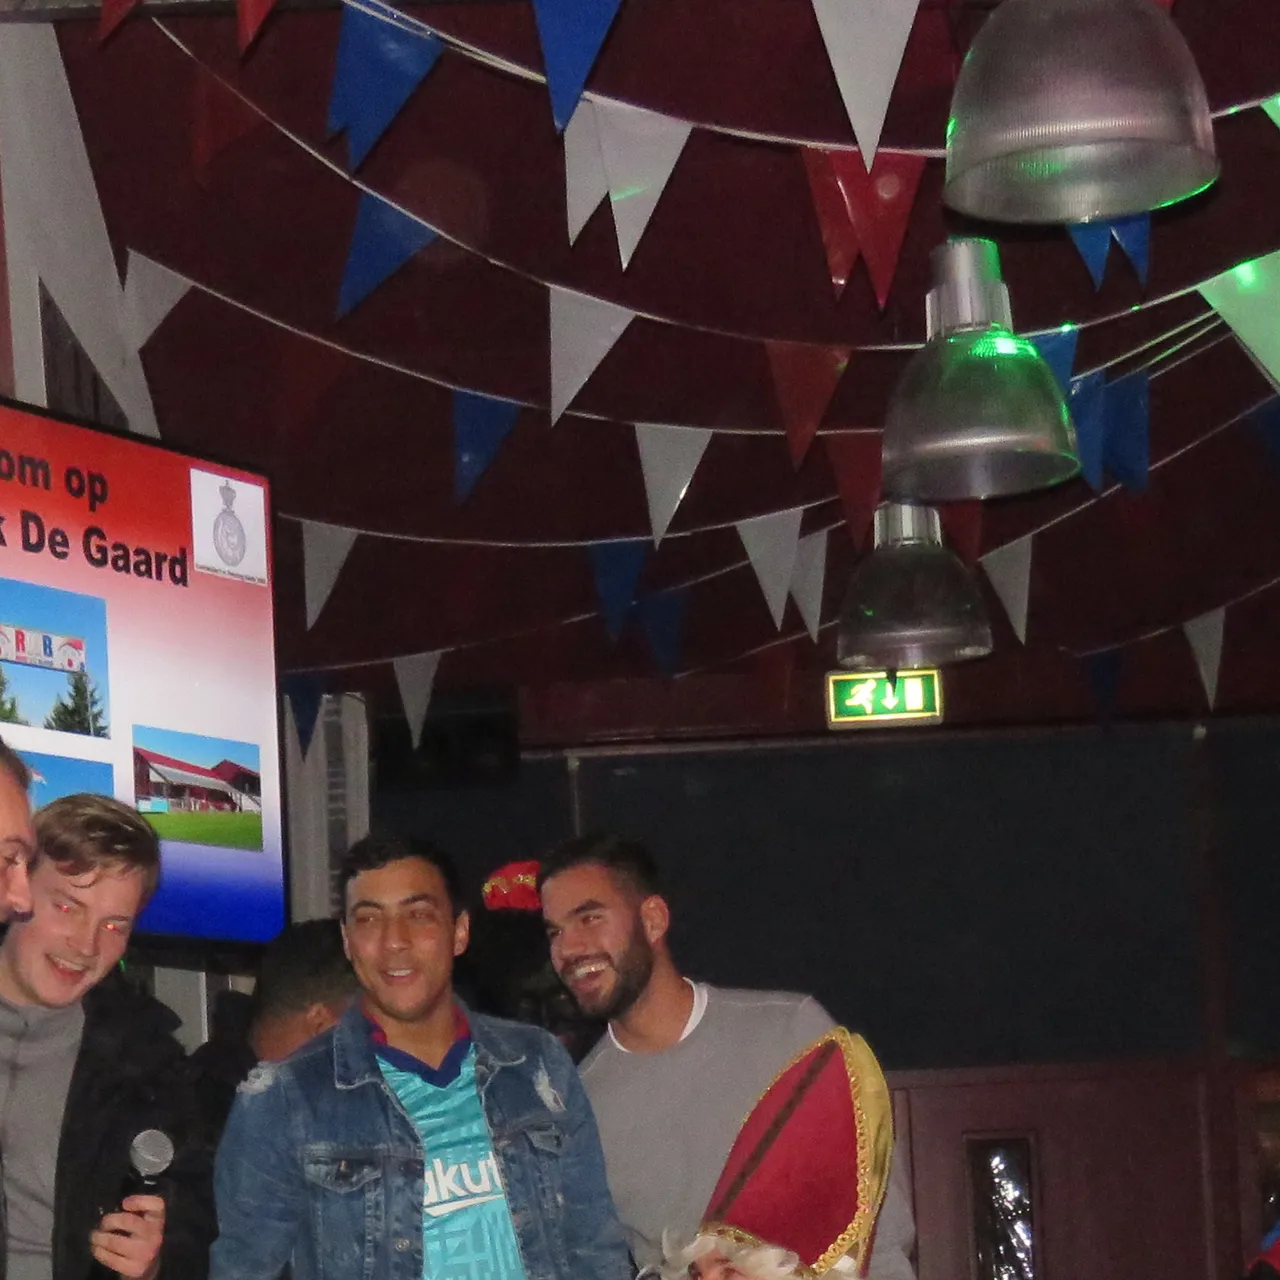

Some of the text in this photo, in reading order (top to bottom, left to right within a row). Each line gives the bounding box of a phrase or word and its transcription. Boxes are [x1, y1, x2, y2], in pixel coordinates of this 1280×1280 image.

[64, 466, 109, 512] op
[21, 509, 70, 560] De
[82, 526, 188, 588] Gaard
